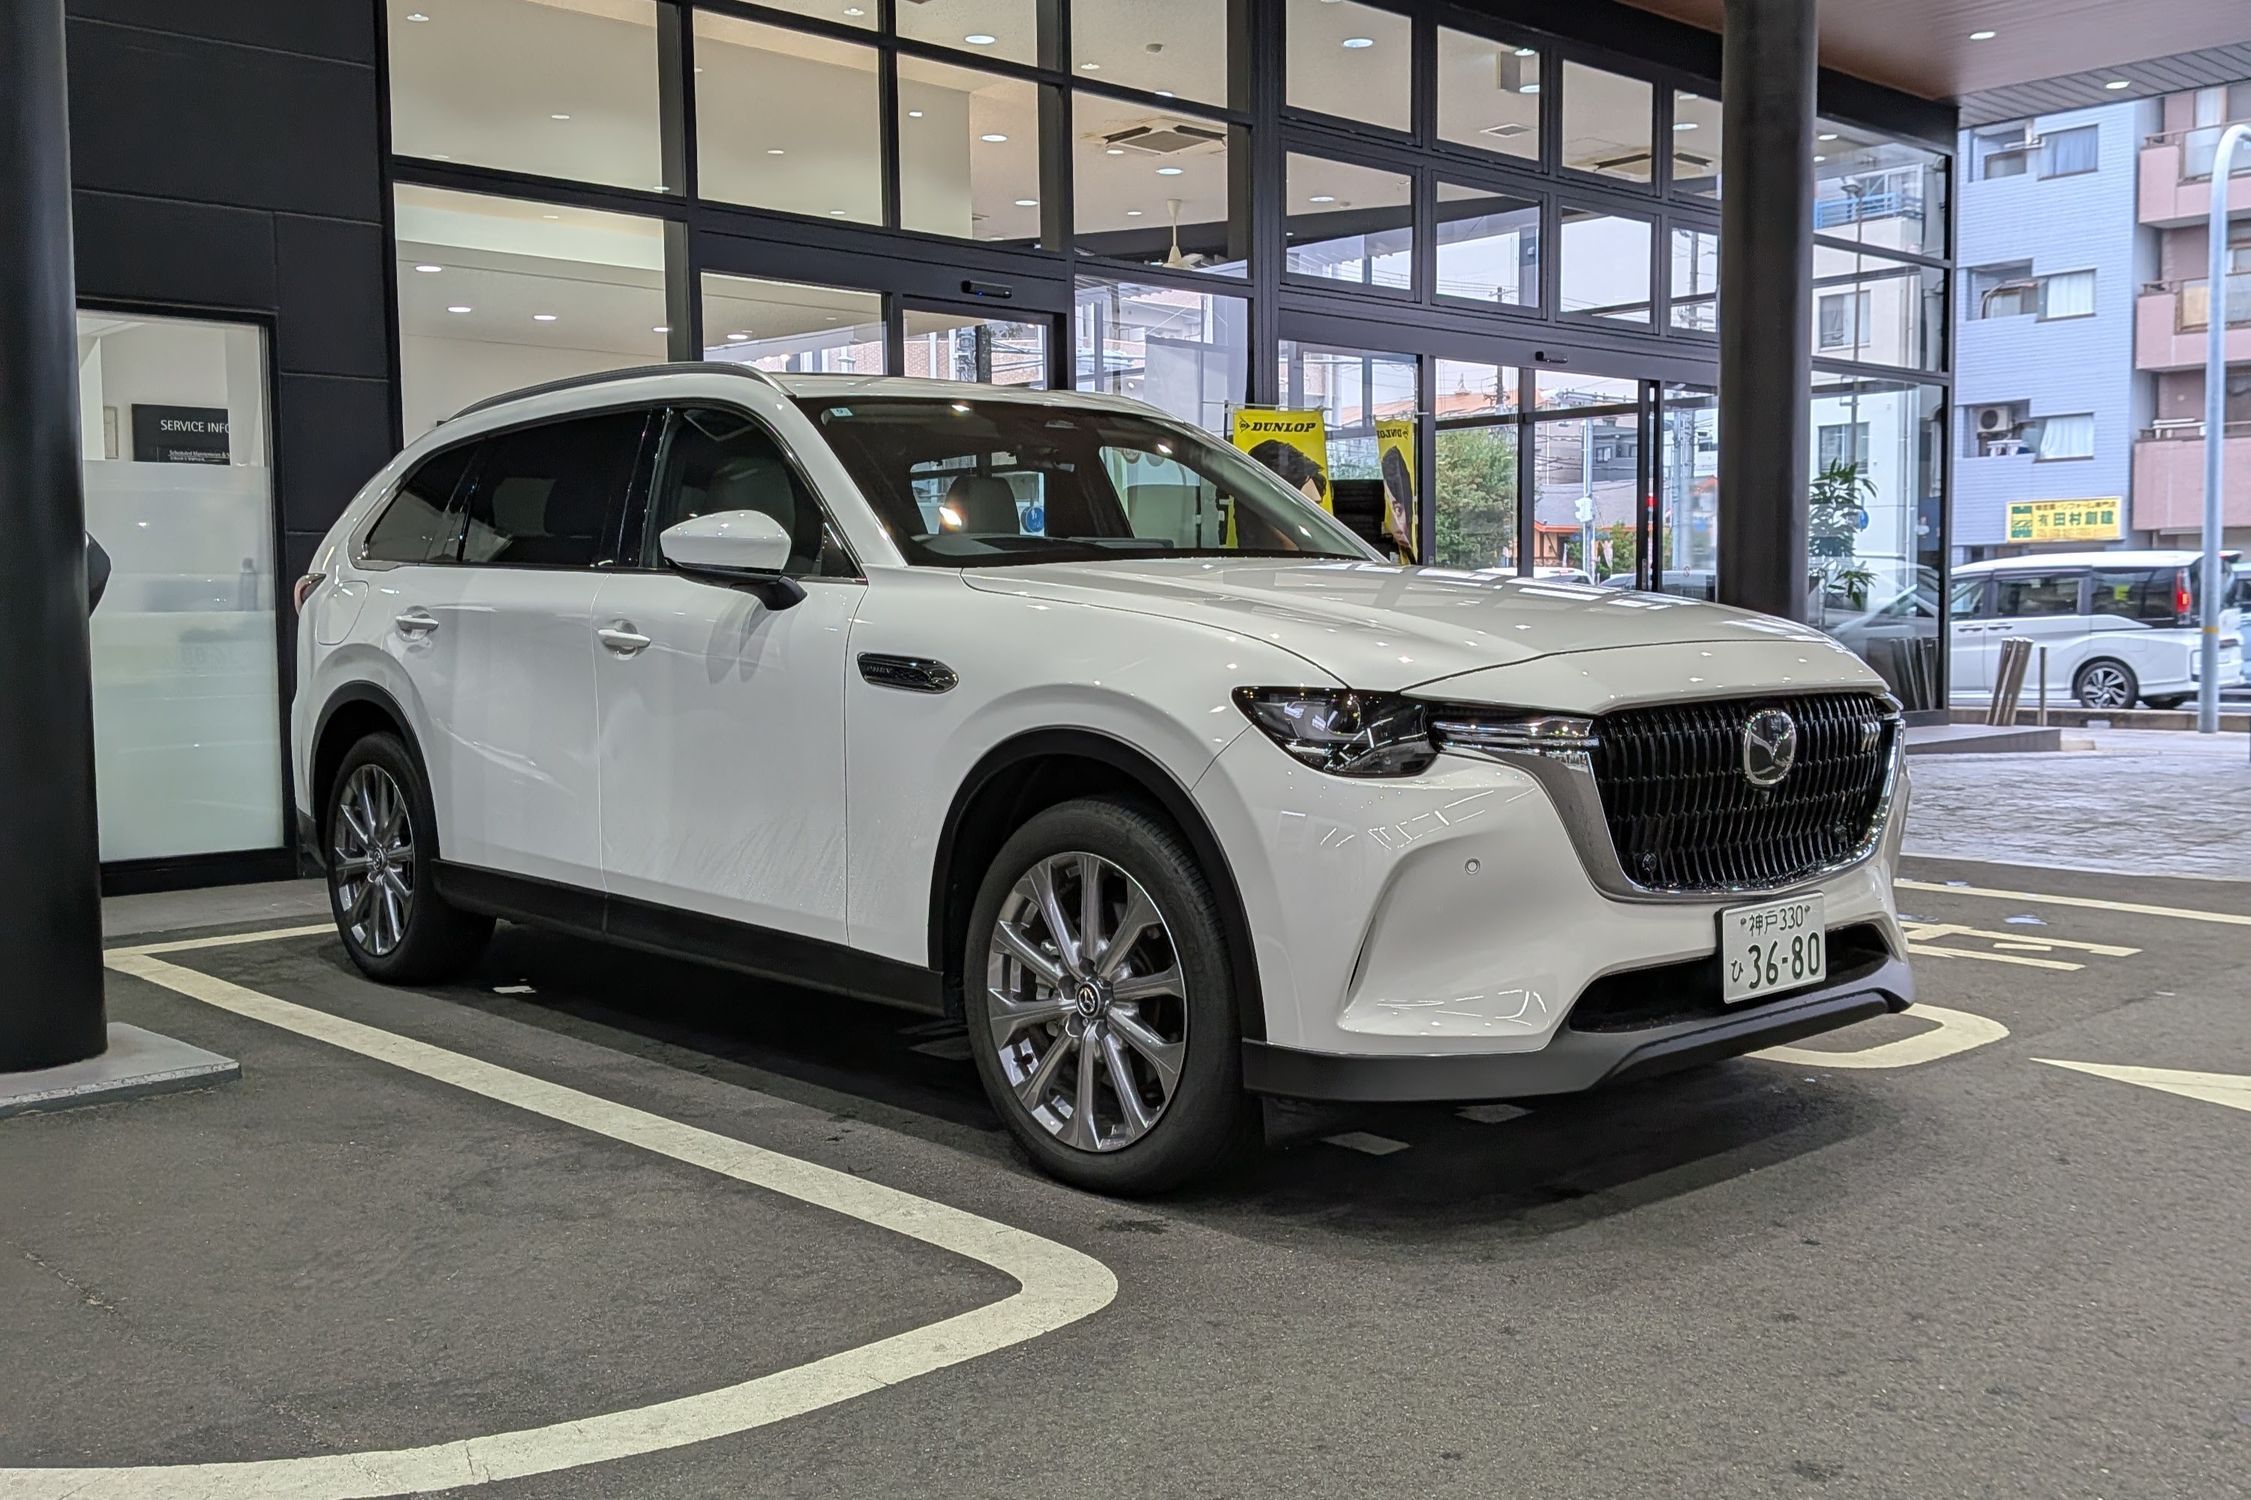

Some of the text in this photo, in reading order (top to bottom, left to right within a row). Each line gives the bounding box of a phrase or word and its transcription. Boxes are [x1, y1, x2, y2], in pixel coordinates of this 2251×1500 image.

[160, 419, 205, 433] SERVICE
[1251, 421, 1316, 433] DUNLOP
[1731, 932, 1820, 990] ひ 36-80
